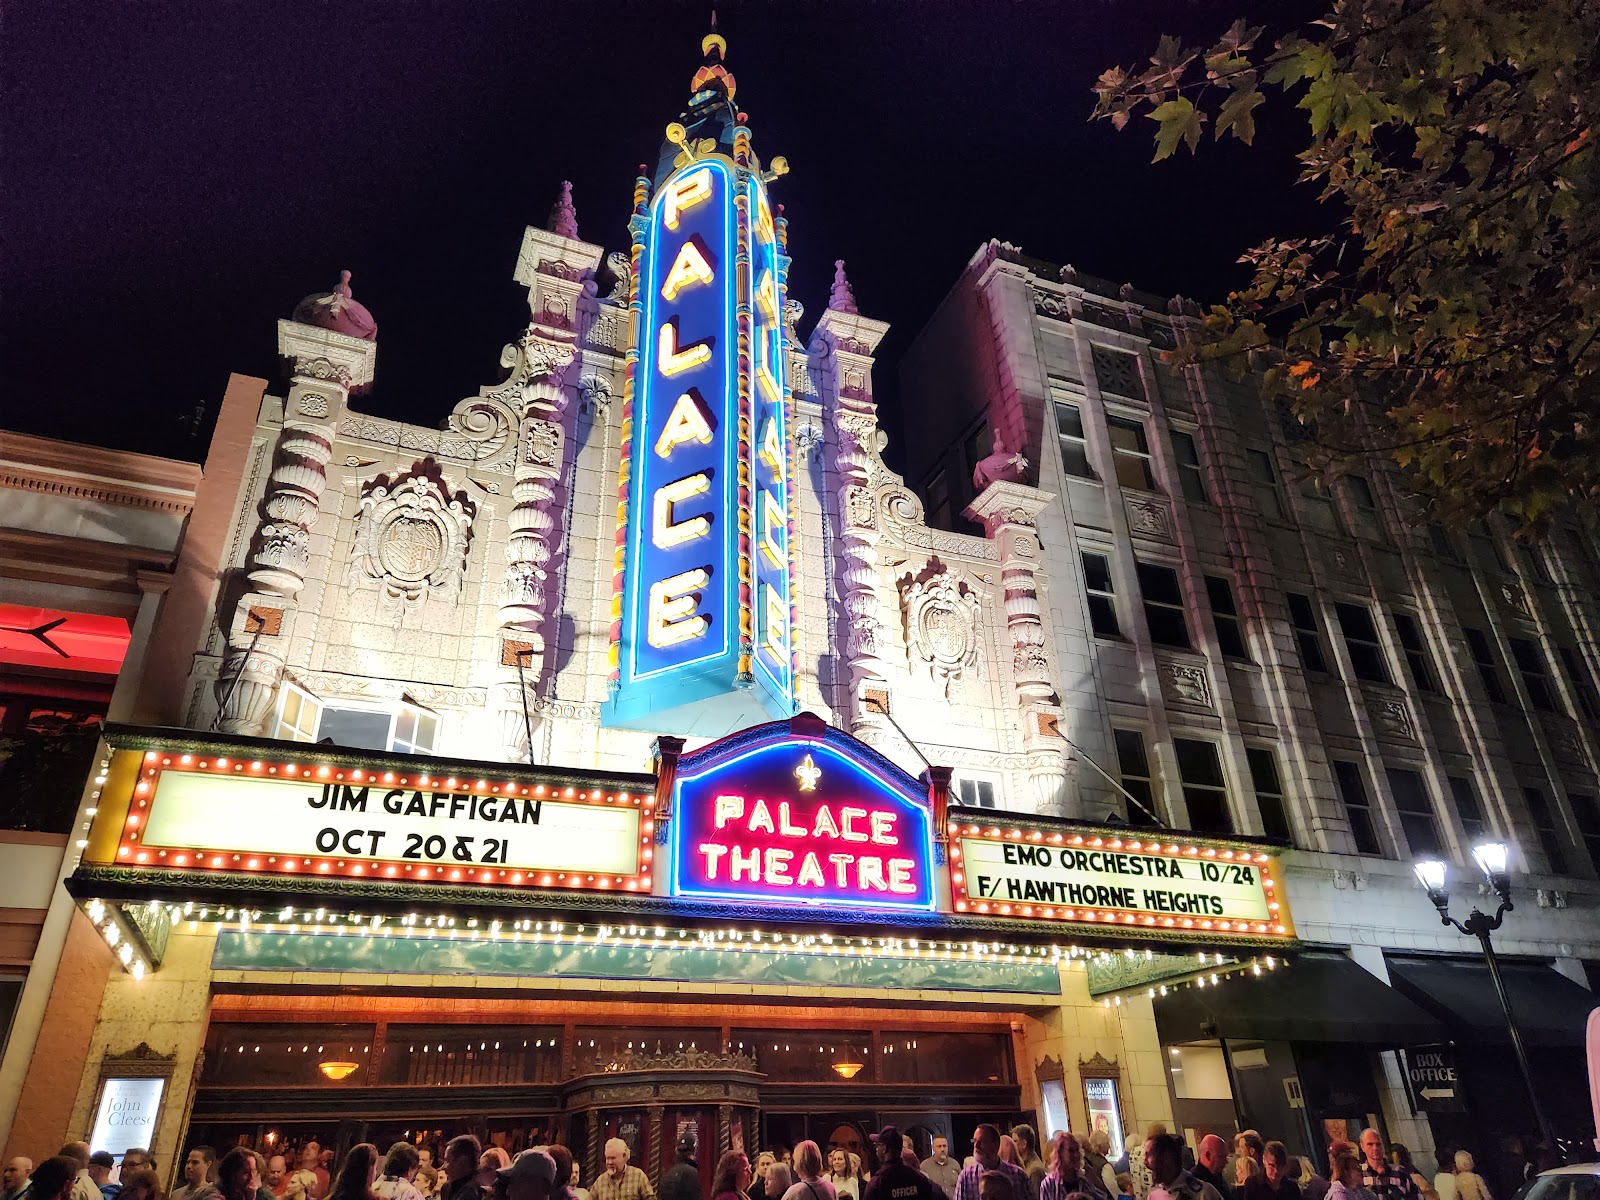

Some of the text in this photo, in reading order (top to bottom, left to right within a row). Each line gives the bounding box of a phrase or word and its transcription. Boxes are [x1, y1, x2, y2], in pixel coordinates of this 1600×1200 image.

[647, 168, 715, 649] PALACE
[307, 783, 542, 825] JIM GAFFIGAN
[714, 795, 899, 845] PALACE
[315, 827, 386, 856] OCT
[698, 843, 917, 894] THEATRE
[1003, 844, 1255, 886] EMO ORCHESTRA 10/24
[1006, 878, 1138, 909] HAWTHORNE
[1143, 889, 1224, 915] HEIGHTS
[1411, 1067, 1457, 1082] OFFICE
[1416, 1053, 1443, 1068] BOX
[106, 1097, 141, 1115] John
[891, 1185, 918, 1199] OFFICER
